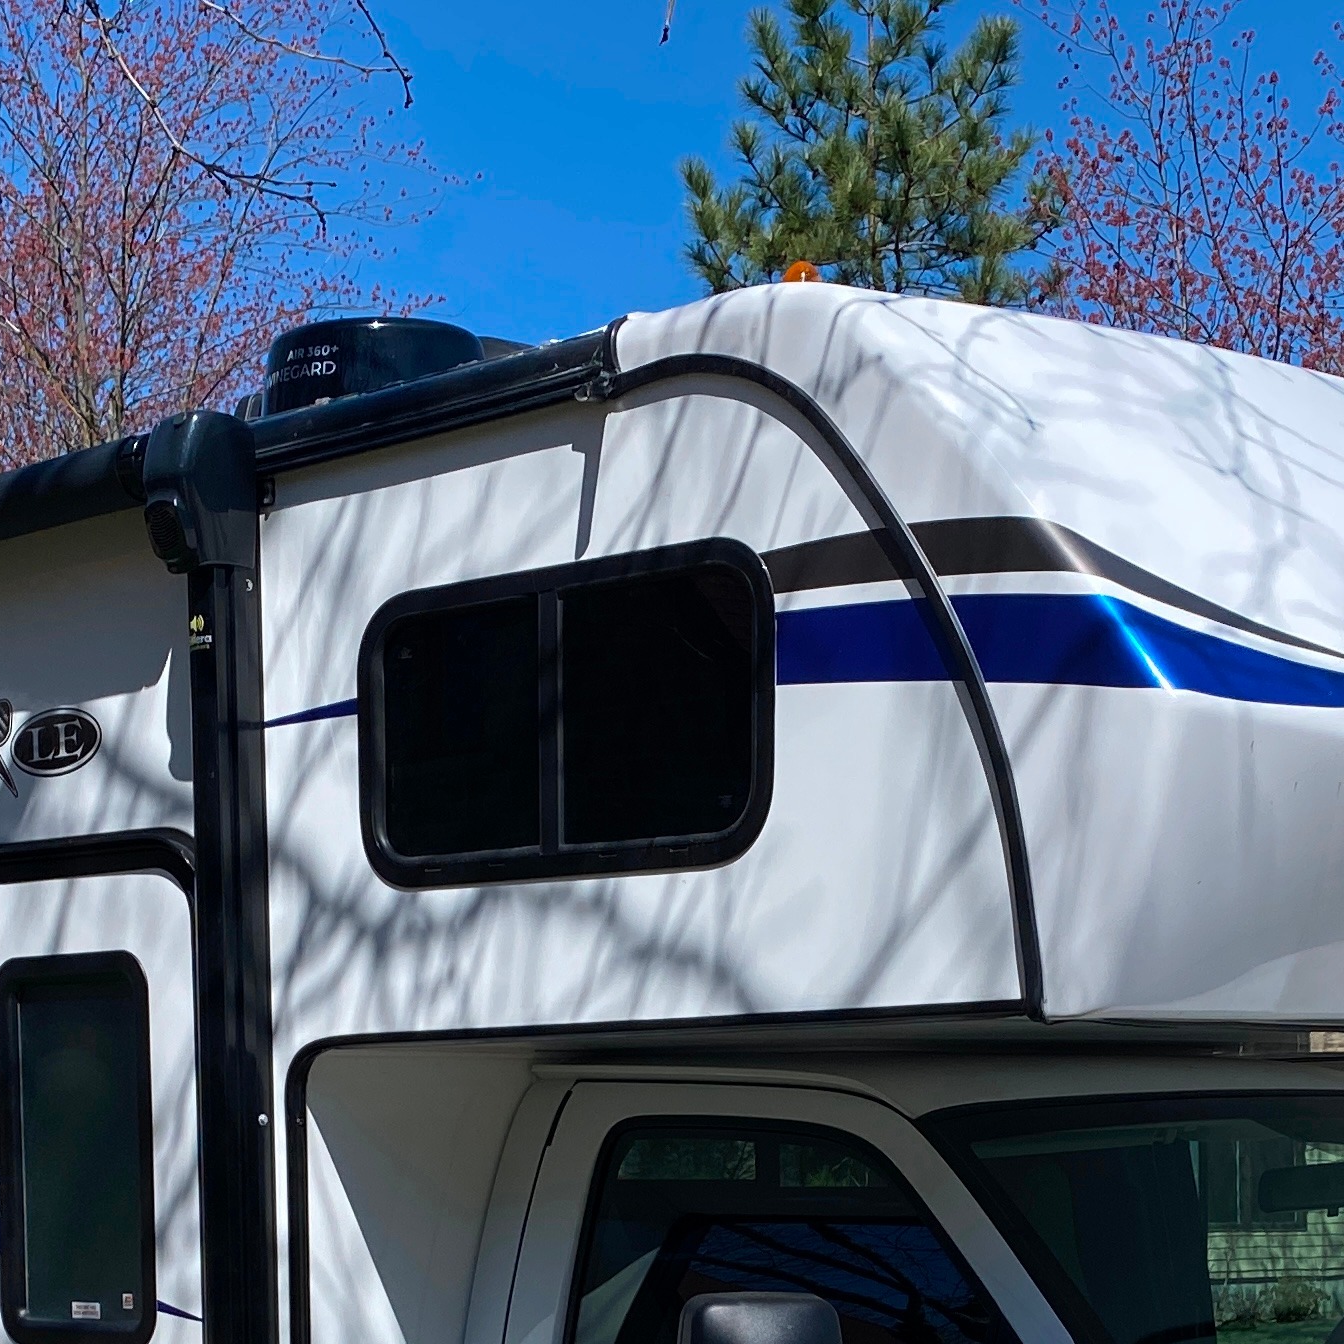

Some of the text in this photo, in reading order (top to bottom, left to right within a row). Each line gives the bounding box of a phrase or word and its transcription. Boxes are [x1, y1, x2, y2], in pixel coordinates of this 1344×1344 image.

[286, 344, 339, 362] AIR 360+
[266, 360, 337, 389] WINEGARD
[25, 718, 85, 764] LE
